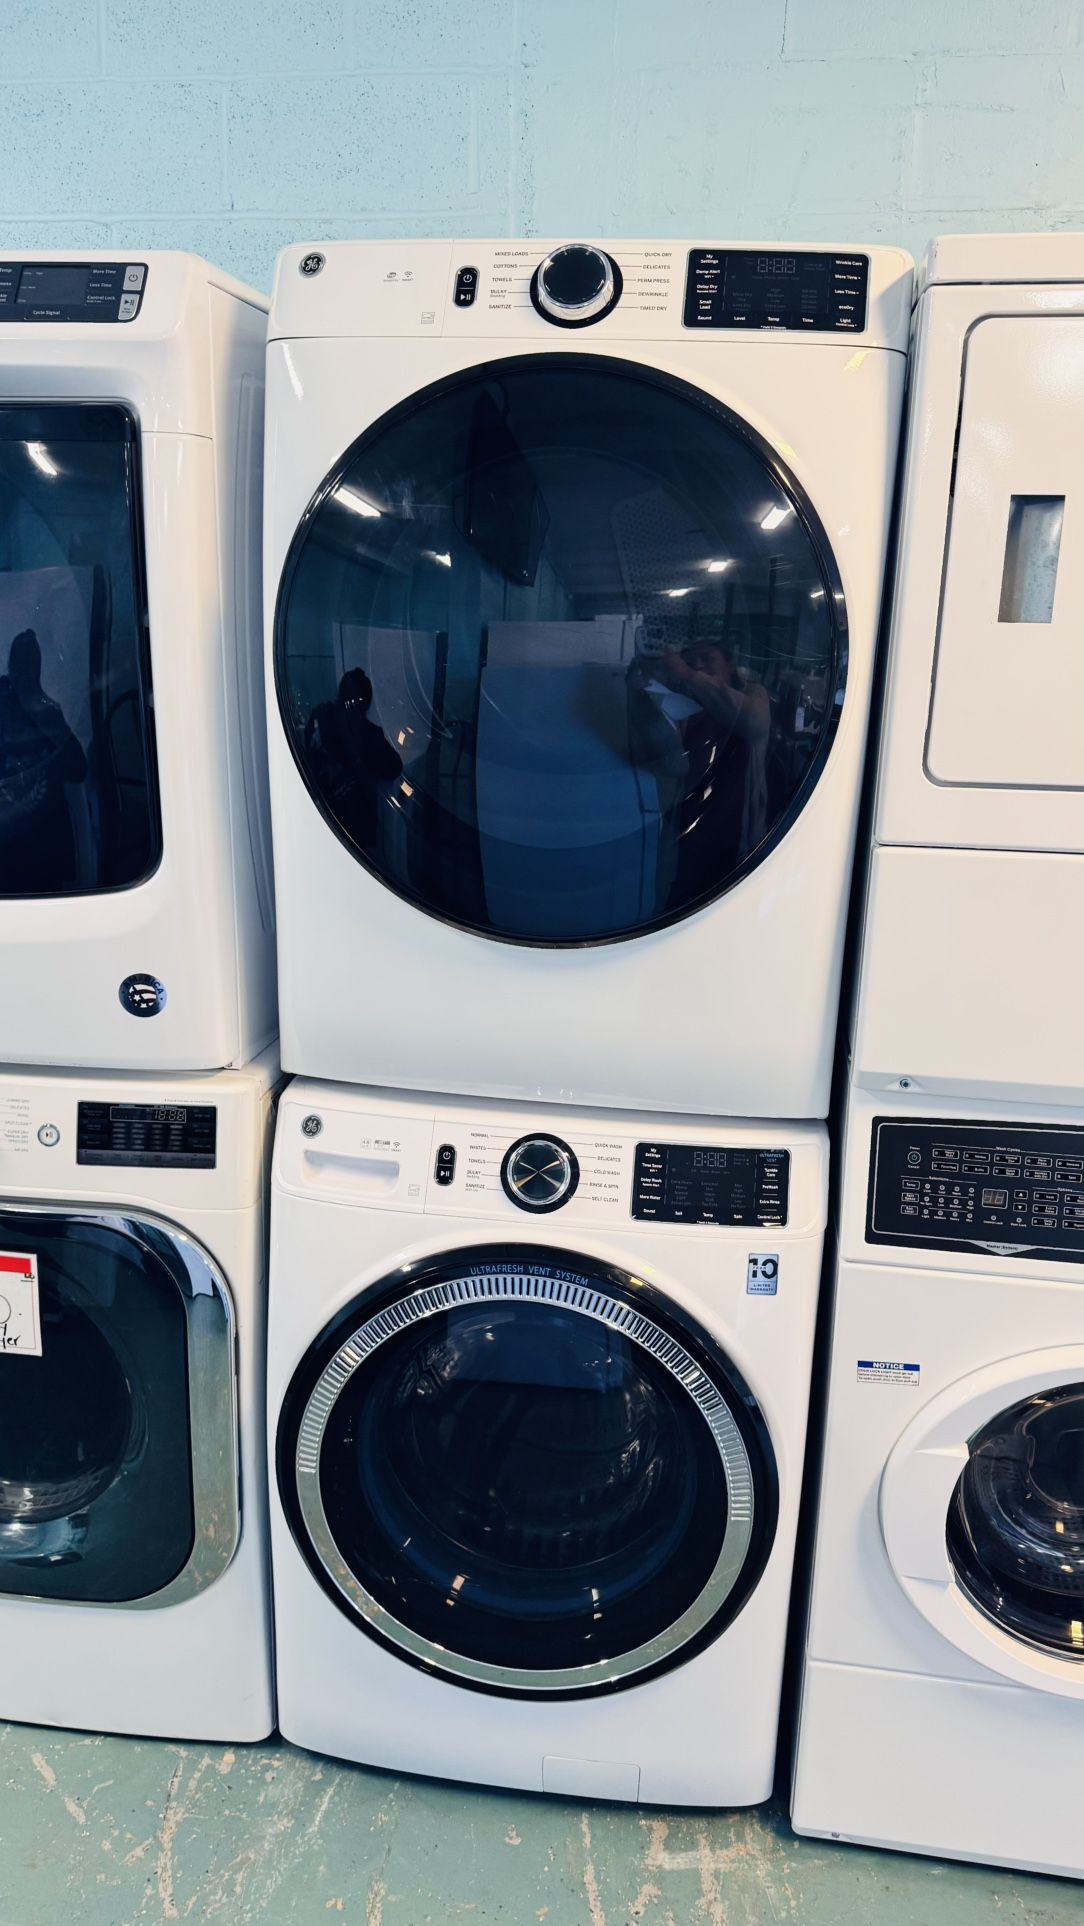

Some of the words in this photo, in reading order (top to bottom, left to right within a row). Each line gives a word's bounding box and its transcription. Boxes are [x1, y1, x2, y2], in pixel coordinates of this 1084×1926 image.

[470, 1264, 524, 1275] ULTRAFRESH
[528, 1265, 551, 1276] VENT
[555, 1270, 588, 1286] SYSTEM
[749, 1258, 778, 1279] 10
